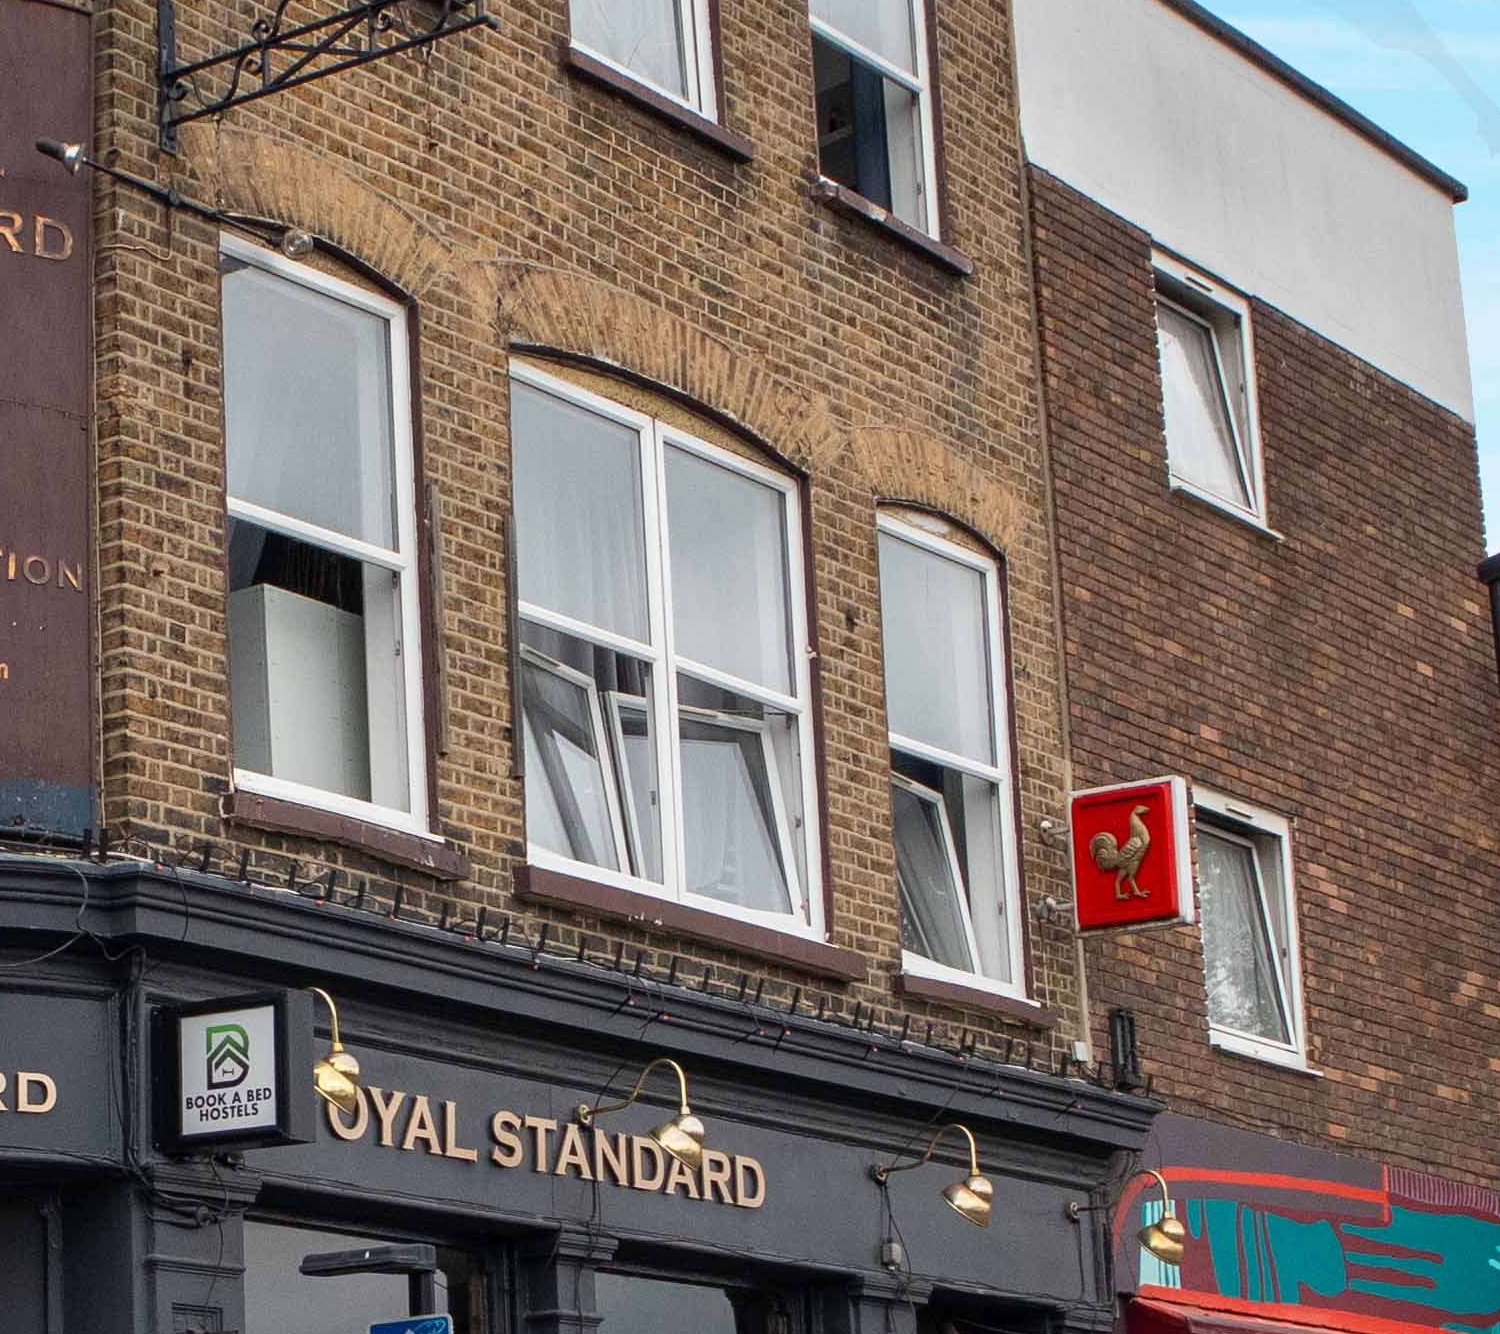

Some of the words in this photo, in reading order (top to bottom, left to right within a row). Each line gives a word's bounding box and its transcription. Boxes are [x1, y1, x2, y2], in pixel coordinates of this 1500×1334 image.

[185, 1093, 226, 1111] BOOK
[230, 1090, 244, 1106] A
[247, 1087, 273, 1103] BED
[199, 1101, 260, 1123] HOSTELS
[327, 1086, 478, 1164] OYAL
